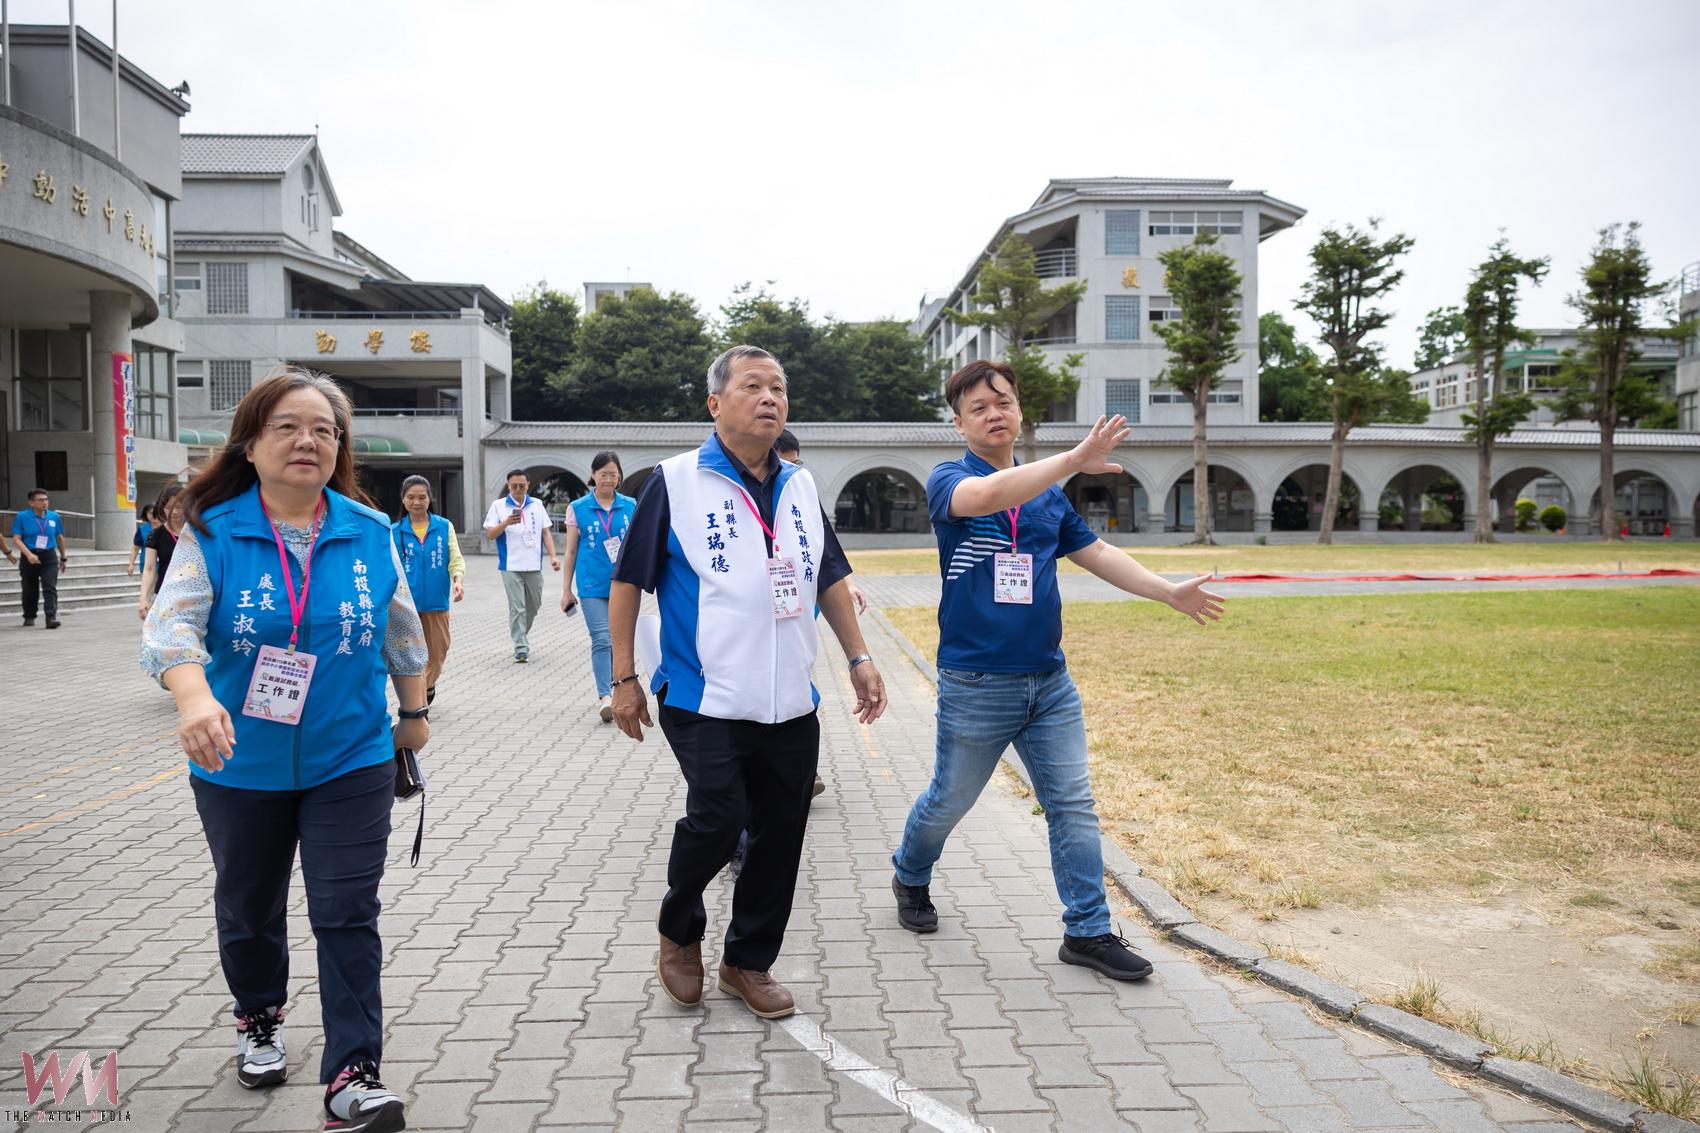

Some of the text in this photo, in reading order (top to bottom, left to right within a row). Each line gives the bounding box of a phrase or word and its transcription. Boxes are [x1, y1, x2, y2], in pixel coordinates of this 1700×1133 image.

[706, 512, 730, 573] 王瑞德
[723, 499, 738, 539] 副縣長
[791, 503, 814, 582] 南投縣政府
[257, 573, 276, 611] 處長
[352, 559, 376, 647] 南投縣政府
[774, 587, 797, 598] 工作證
[999, 578, 1028, 586] 工作證
[231, 590, 257, 657] 王淑玲
[335, 601, 357, 655] 教育處
[256, 683, 300, 700] 工作證
